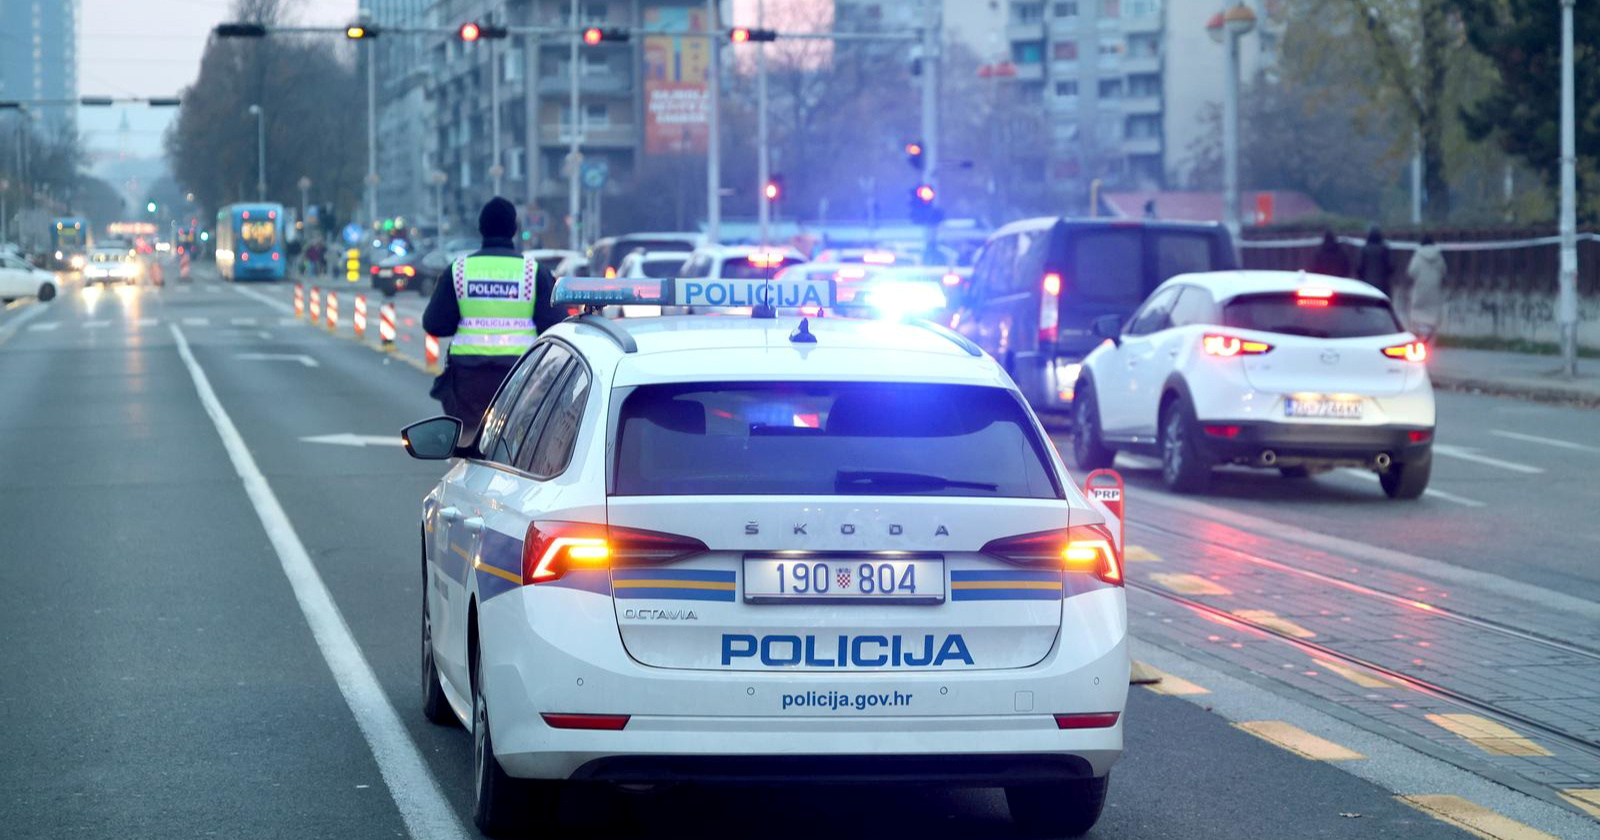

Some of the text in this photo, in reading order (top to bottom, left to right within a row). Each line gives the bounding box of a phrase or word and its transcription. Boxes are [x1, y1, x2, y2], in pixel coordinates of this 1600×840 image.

[469, 283, 518, 296] POLICIJA
[685, 282, 822, 306] POLICIJA
[475, 319, 511, 328] POLICIJA
[1094, 490, 1119, 498] PRP
[745, 521, 949, 536] ŠKODA
[776, 563, 916, 593] 190 804
[624, 609, 698, 620] OCTAVIA
[721, 634, 975, 667] POLICIJA
[782, 691, 913, 710] policija.gov.hr
